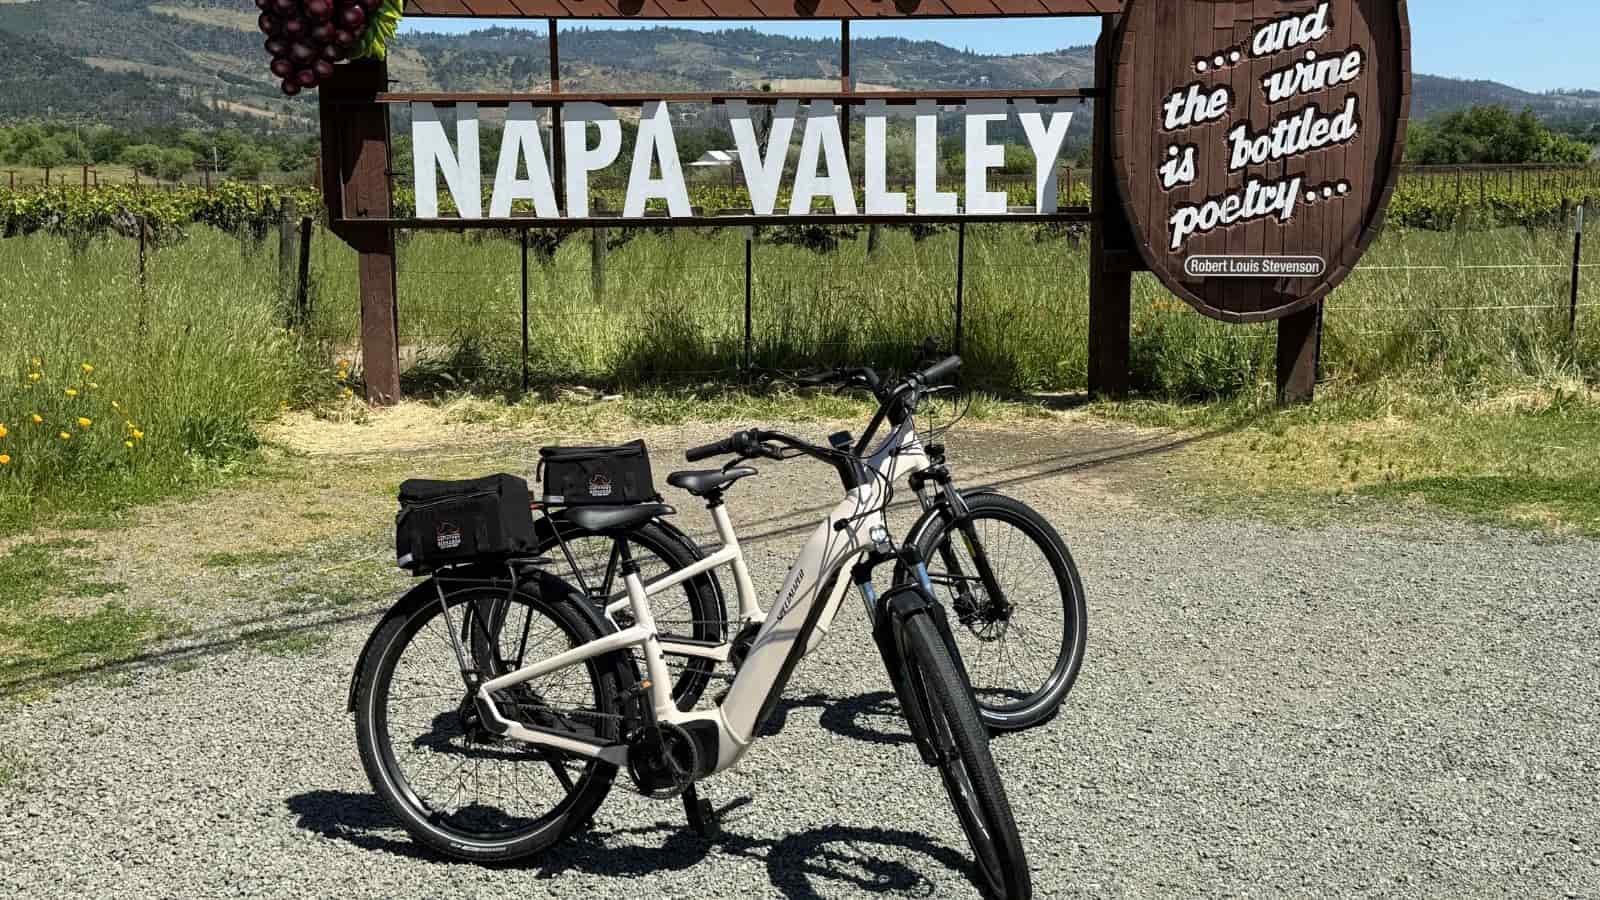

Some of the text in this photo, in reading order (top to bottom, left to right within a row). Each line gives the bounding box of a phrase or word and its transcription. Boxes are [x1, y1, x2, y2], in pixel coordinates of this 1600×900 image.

[1163, 50, 1362, 130] the wine
[411, 99, 1075, 218] NAPA VALLEY
[1159, 97, 1358, 188] is bottled
[1191, 259, 1320, 274] Robert Louis Stevenson
